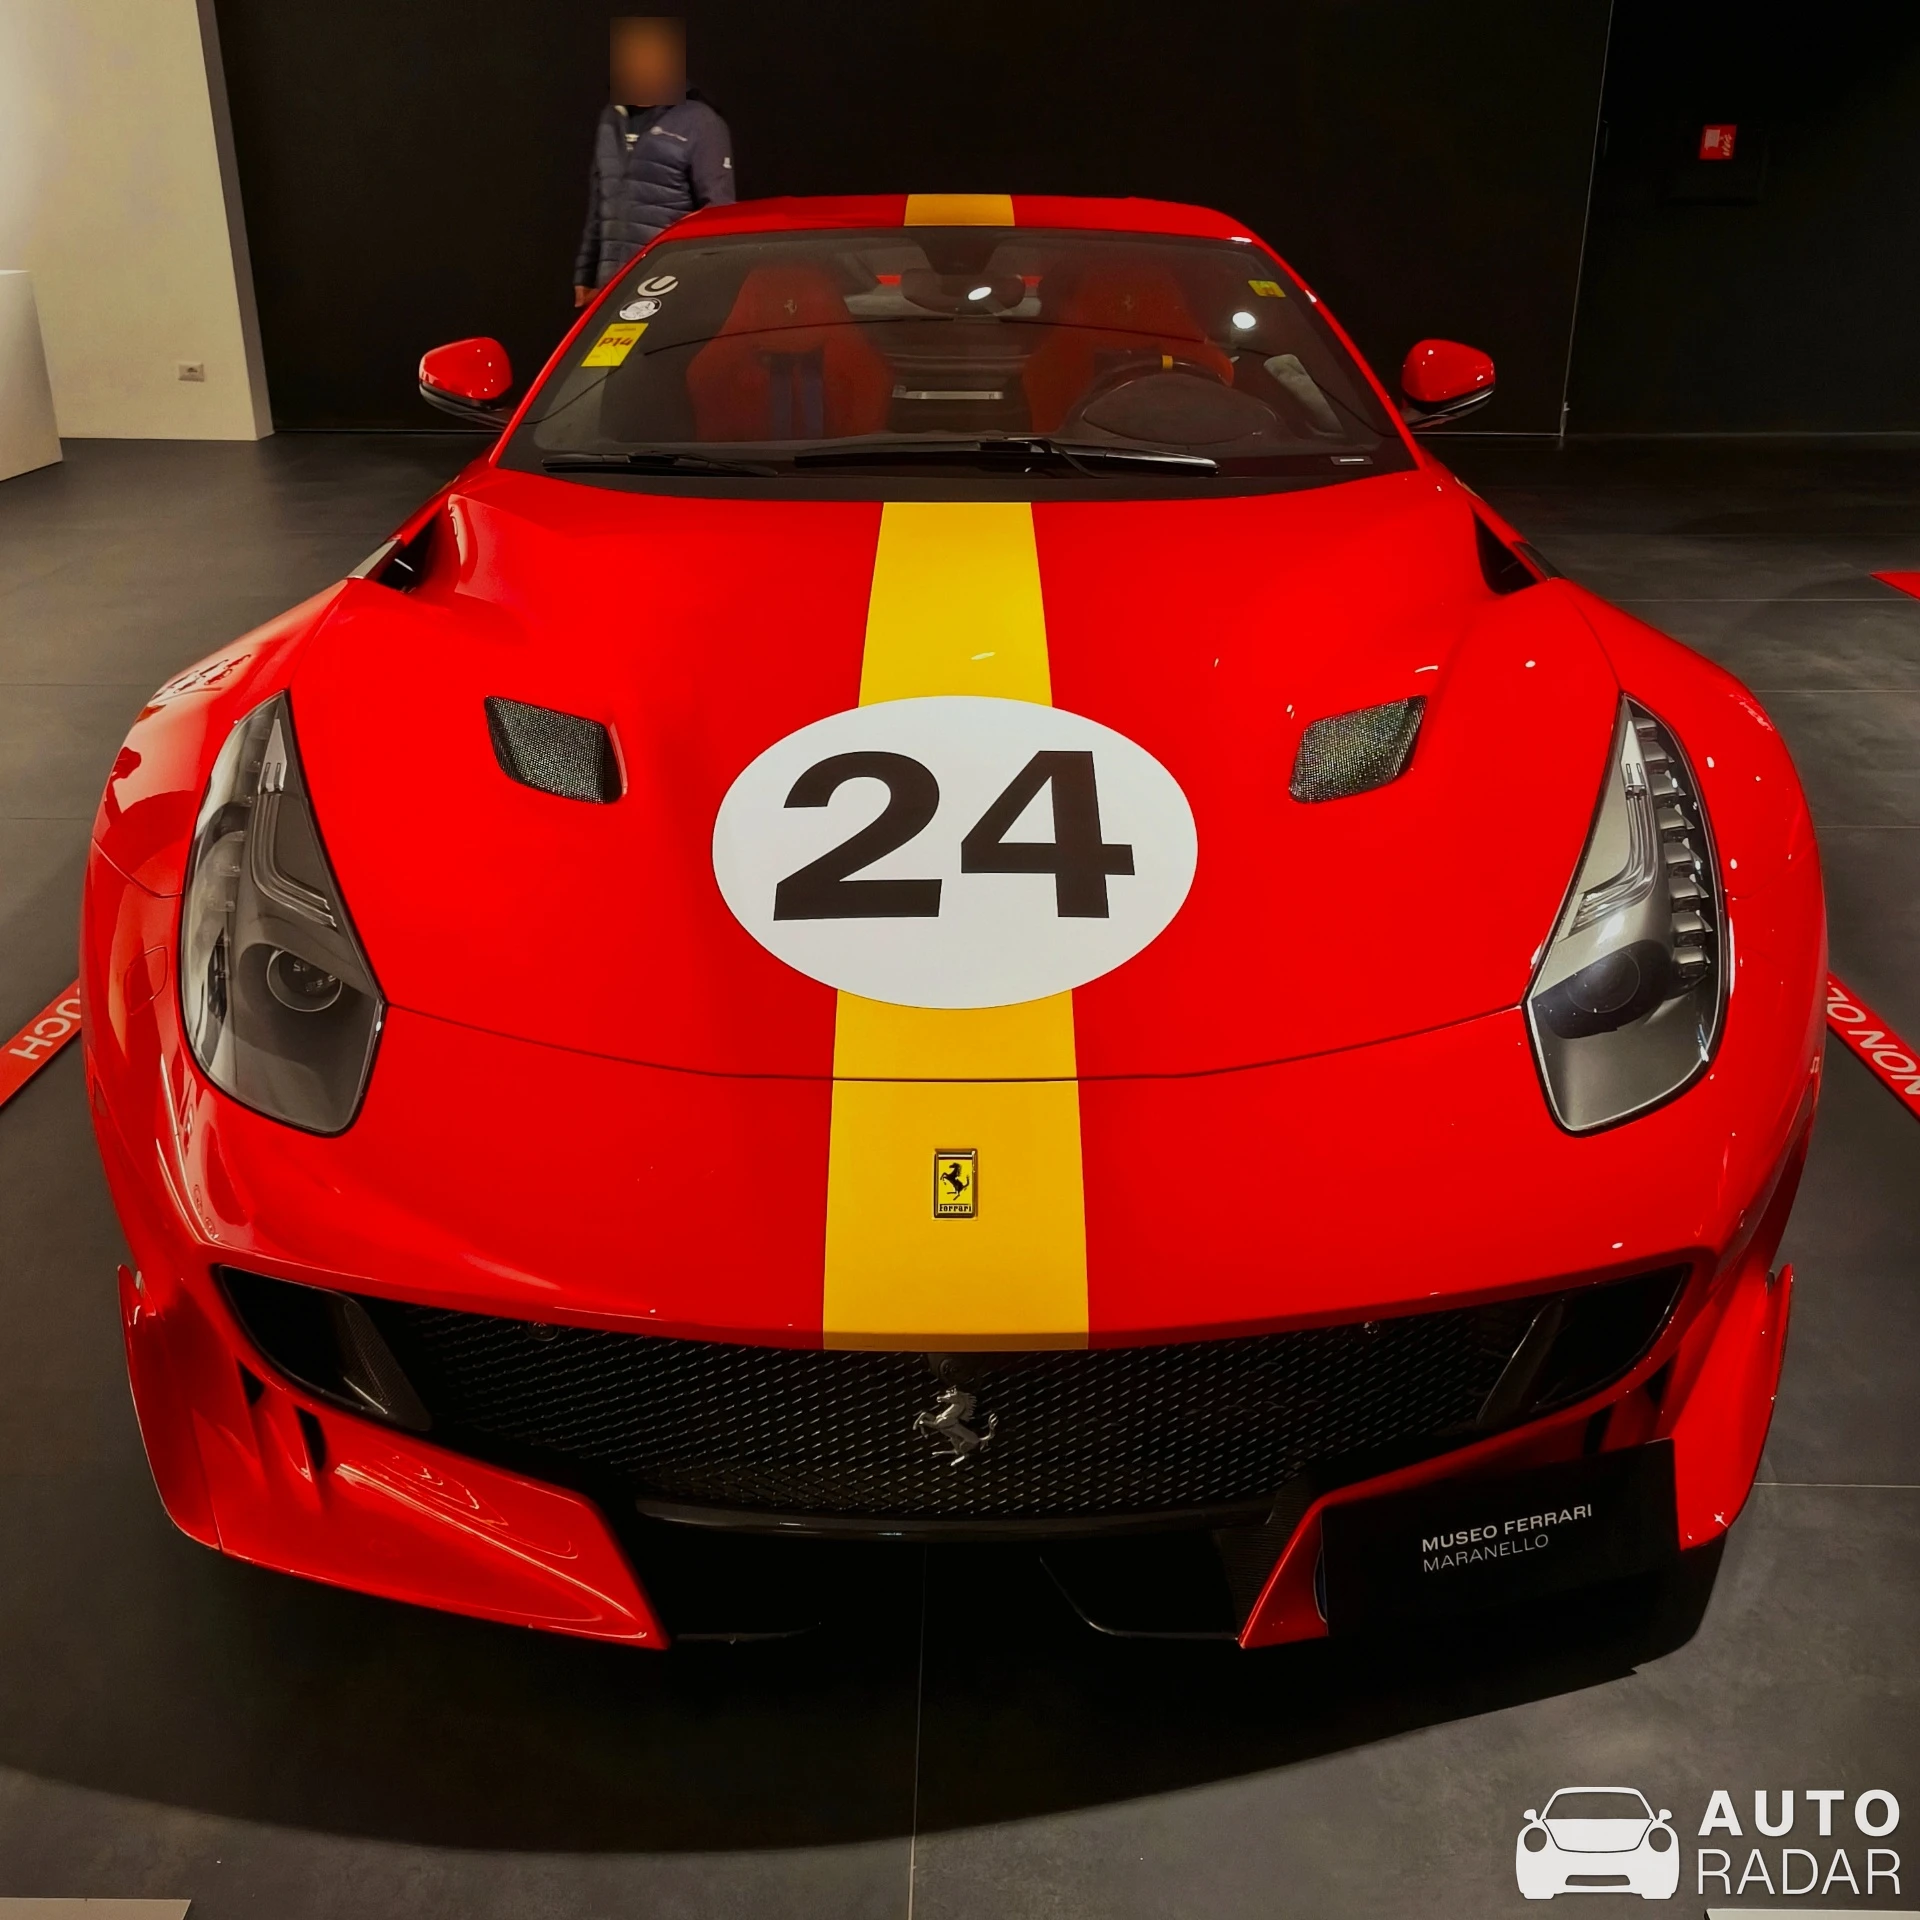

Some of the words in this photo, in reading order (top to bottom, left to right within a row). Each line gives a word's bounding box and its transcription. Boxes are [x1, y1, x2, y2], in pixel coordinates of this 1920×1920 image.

[597, 336, 634, 348] P14
[773, 750, 1135, 921] 24
[1422, 1525, 1498, 1552] MUSEO
[1504, 1503, 1592, 1535] FERRARI
[1423, 1534, 1549, 1573] MARANELLO
